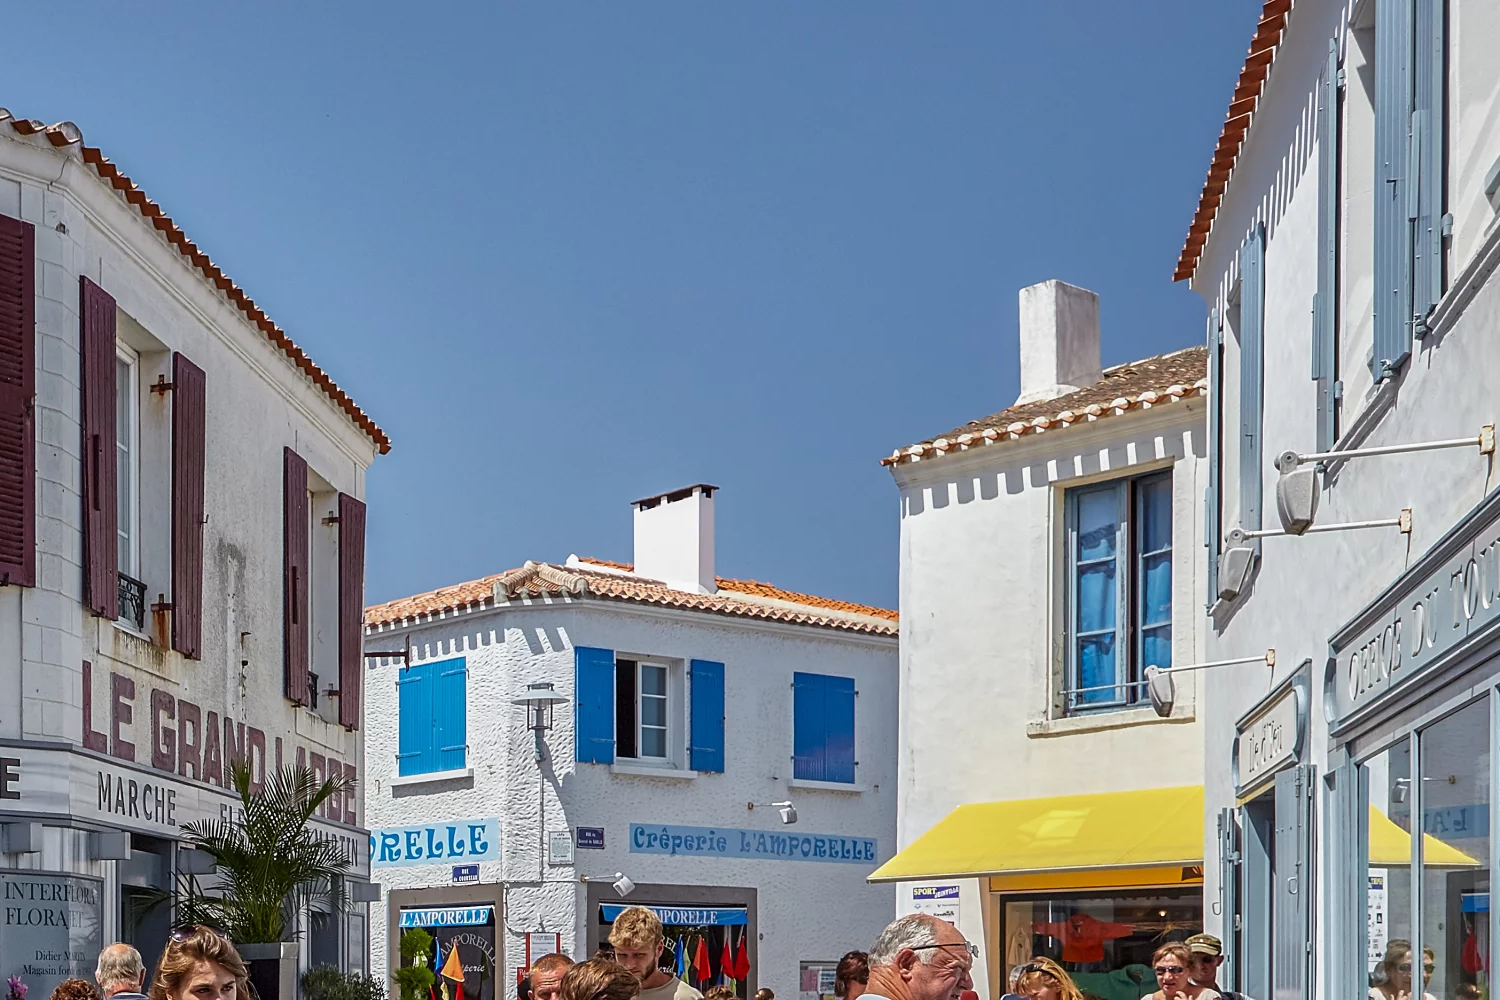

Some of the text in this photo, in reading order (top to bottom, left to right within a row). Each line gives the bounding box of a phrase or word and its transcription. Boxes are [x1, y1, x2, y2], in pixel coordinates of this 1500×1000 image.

[1349, 618, 1402, 701] OFFICE
[1412, 586, 1439, 659] DU
[82, 660, 136, 762] LE
[151, 688, 266, 800] GRAND
[98, 771, 176, 826] MARCHE
[633, 826, 875, 861] Crêperie L'AMPORELLE
[4, 881, 96, 905] INTERFLORA
[913, 888, 937, 896] SPORT
[401, 909, 488, 926] L'AMPORELLE
[35, 950, 61, 961] Didier
[23, 965, 57, 976] Magasin
